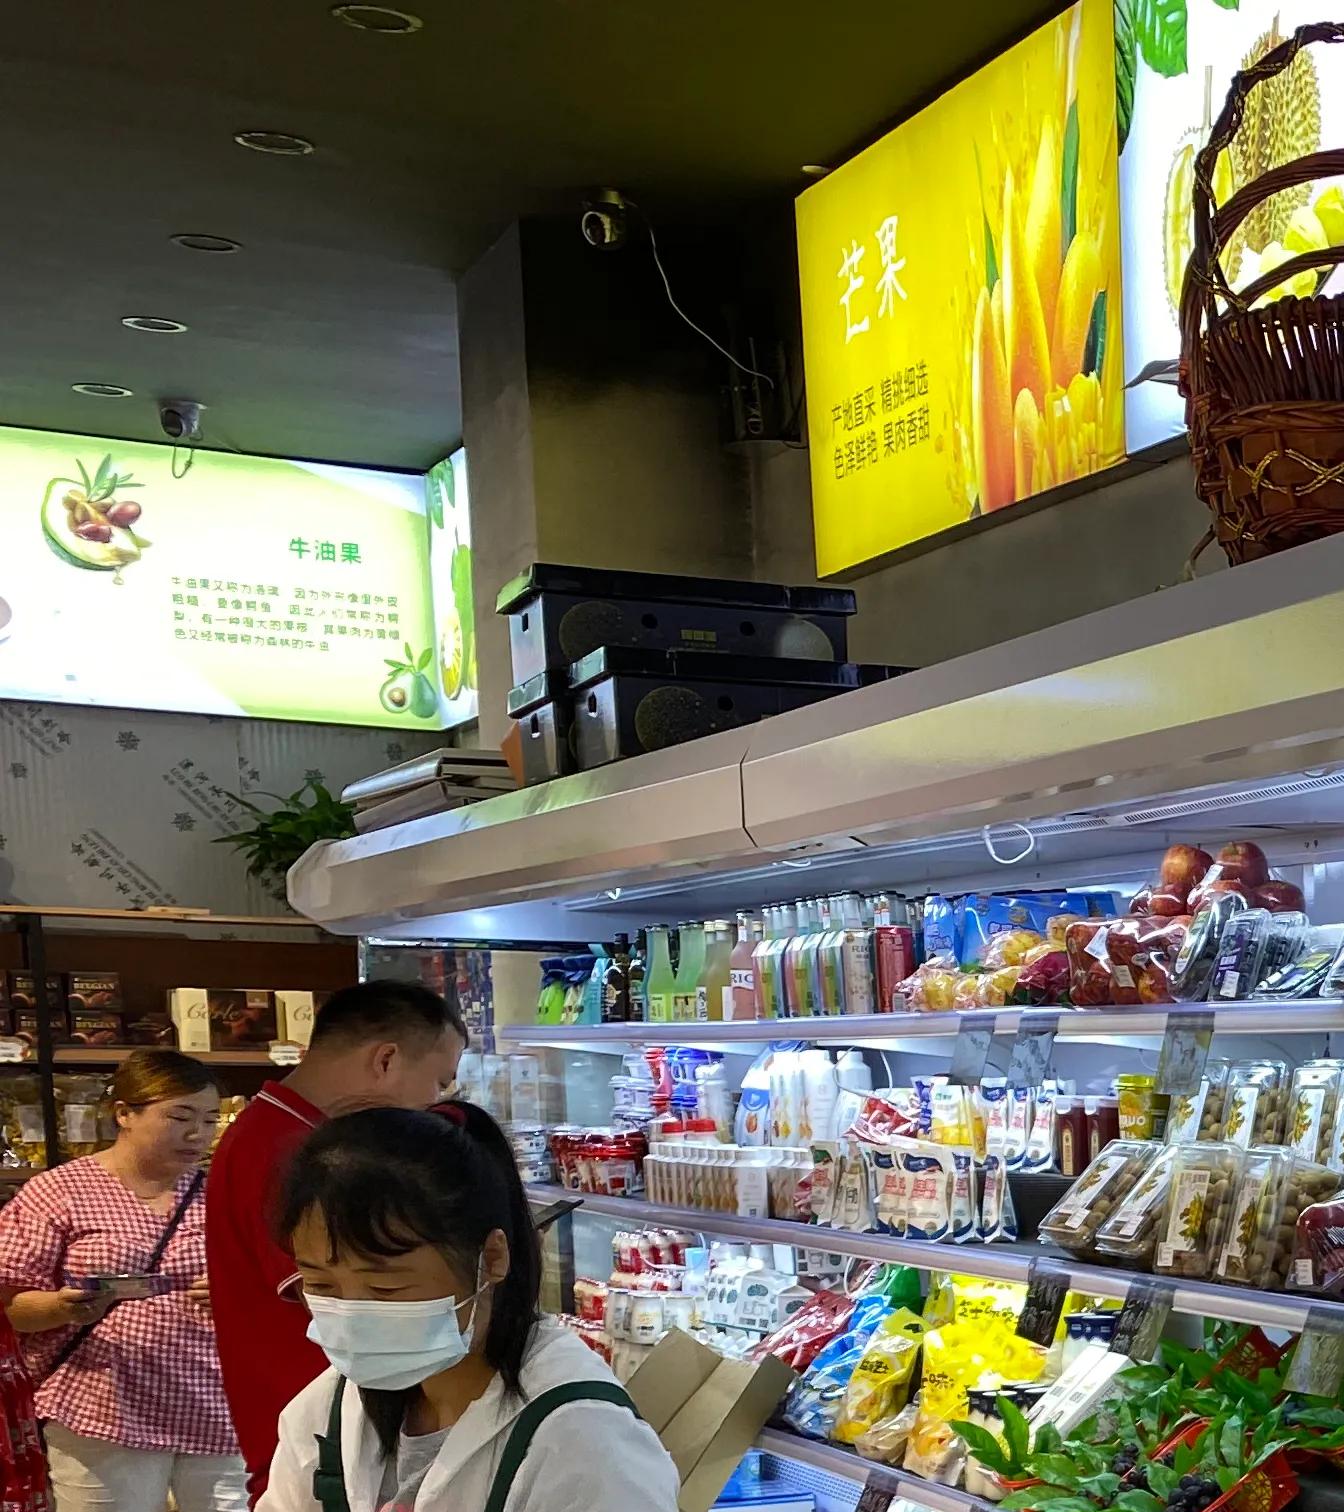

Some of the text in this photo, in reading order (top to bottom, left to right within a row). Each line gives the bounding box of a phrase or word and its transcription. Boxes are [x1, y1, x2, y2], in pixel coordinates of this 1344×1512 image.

[837, 215, 908, 345] 芒果
[831, 359, 929, 437] 产地直采 精挑细选
[882, 405, 930, 458] 果肉香甜
[288, 536, 362, 564] 牛油果
